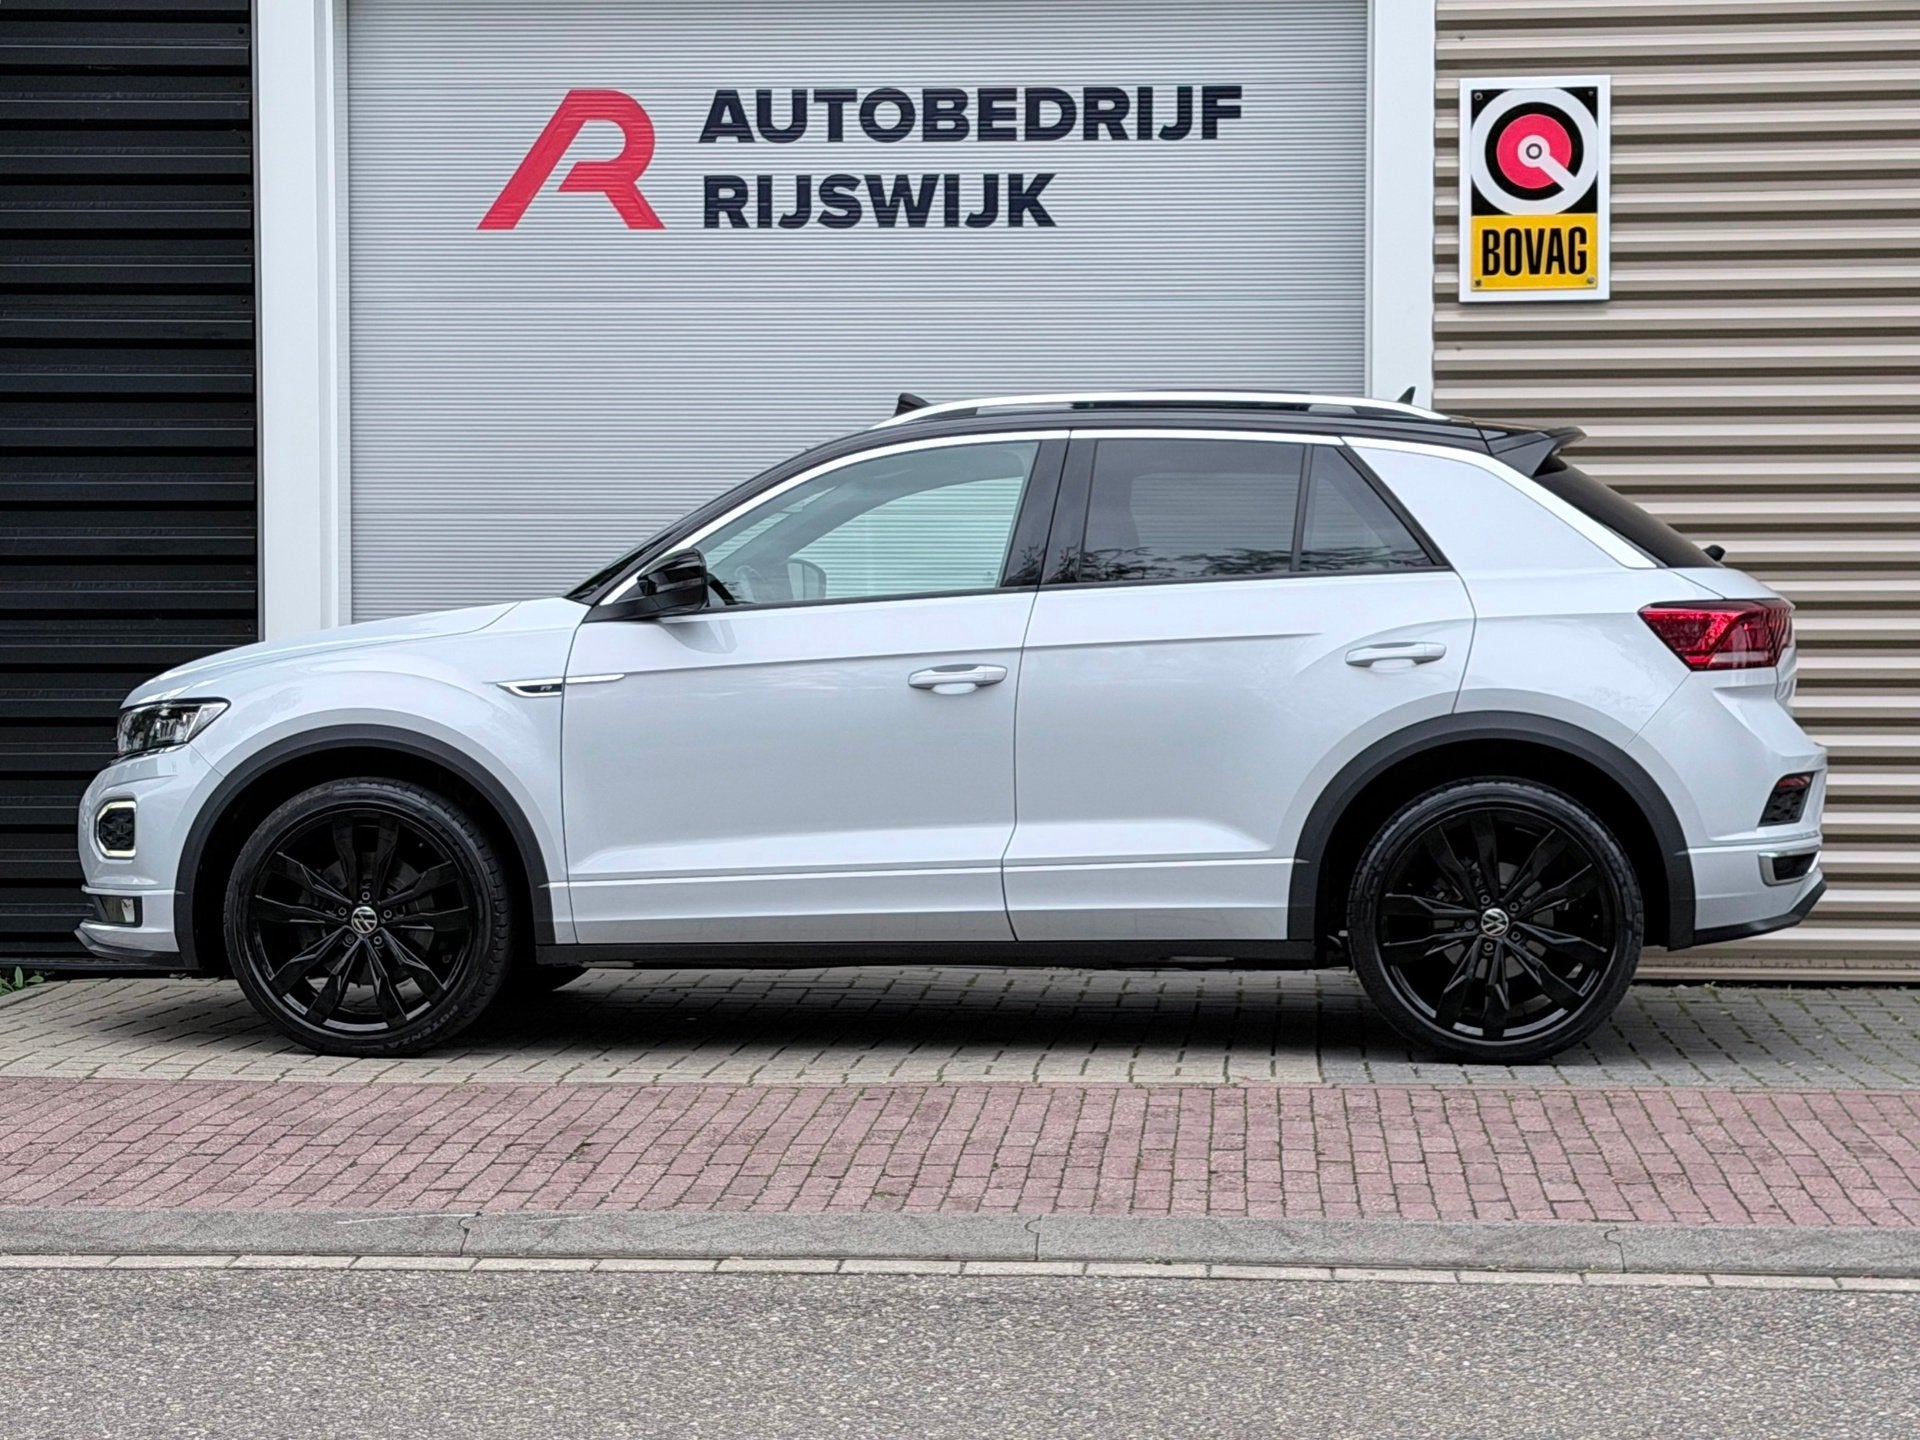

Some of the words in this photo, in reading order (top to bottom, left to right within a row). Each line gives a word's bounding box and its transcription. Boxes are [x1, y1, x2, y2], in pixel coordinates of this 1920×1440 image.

[698, 85, 1242, 143] AUTOBEDRIJF
[703, 173, 1056, 229] RIJSWIJK
[1482, 226, 1587, 276] BOVAG
